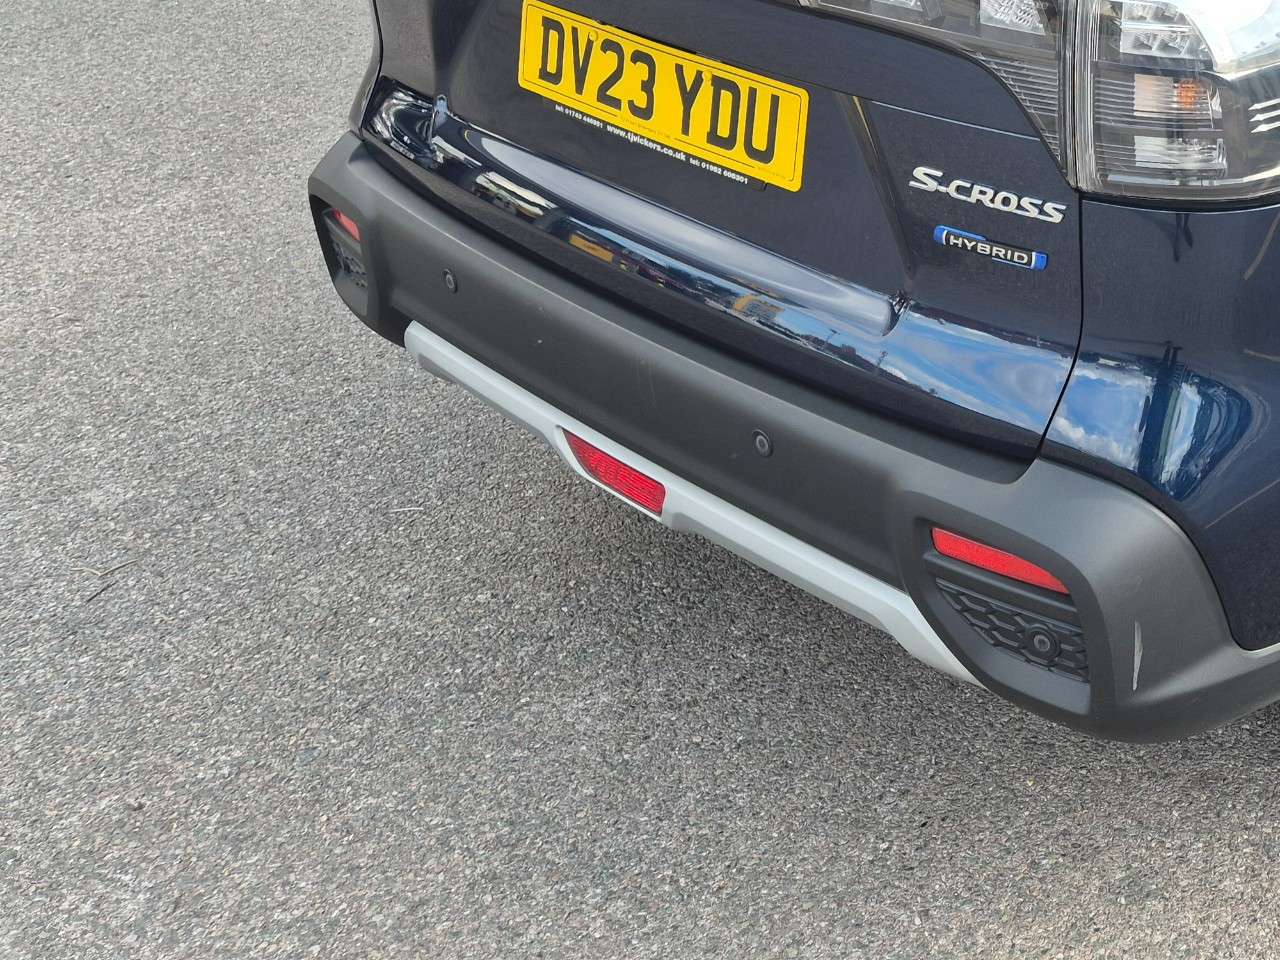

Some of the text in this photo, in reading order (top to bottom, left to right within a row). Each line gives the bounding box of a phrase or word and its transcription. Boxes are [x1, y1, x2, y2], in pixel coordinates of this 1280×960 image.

[538, 16, 780, 165] DV23 YDU
[606, 124, 686, 161] www.tjvickers.co.uk
[950, 233, 1029, 265] HYBRID
